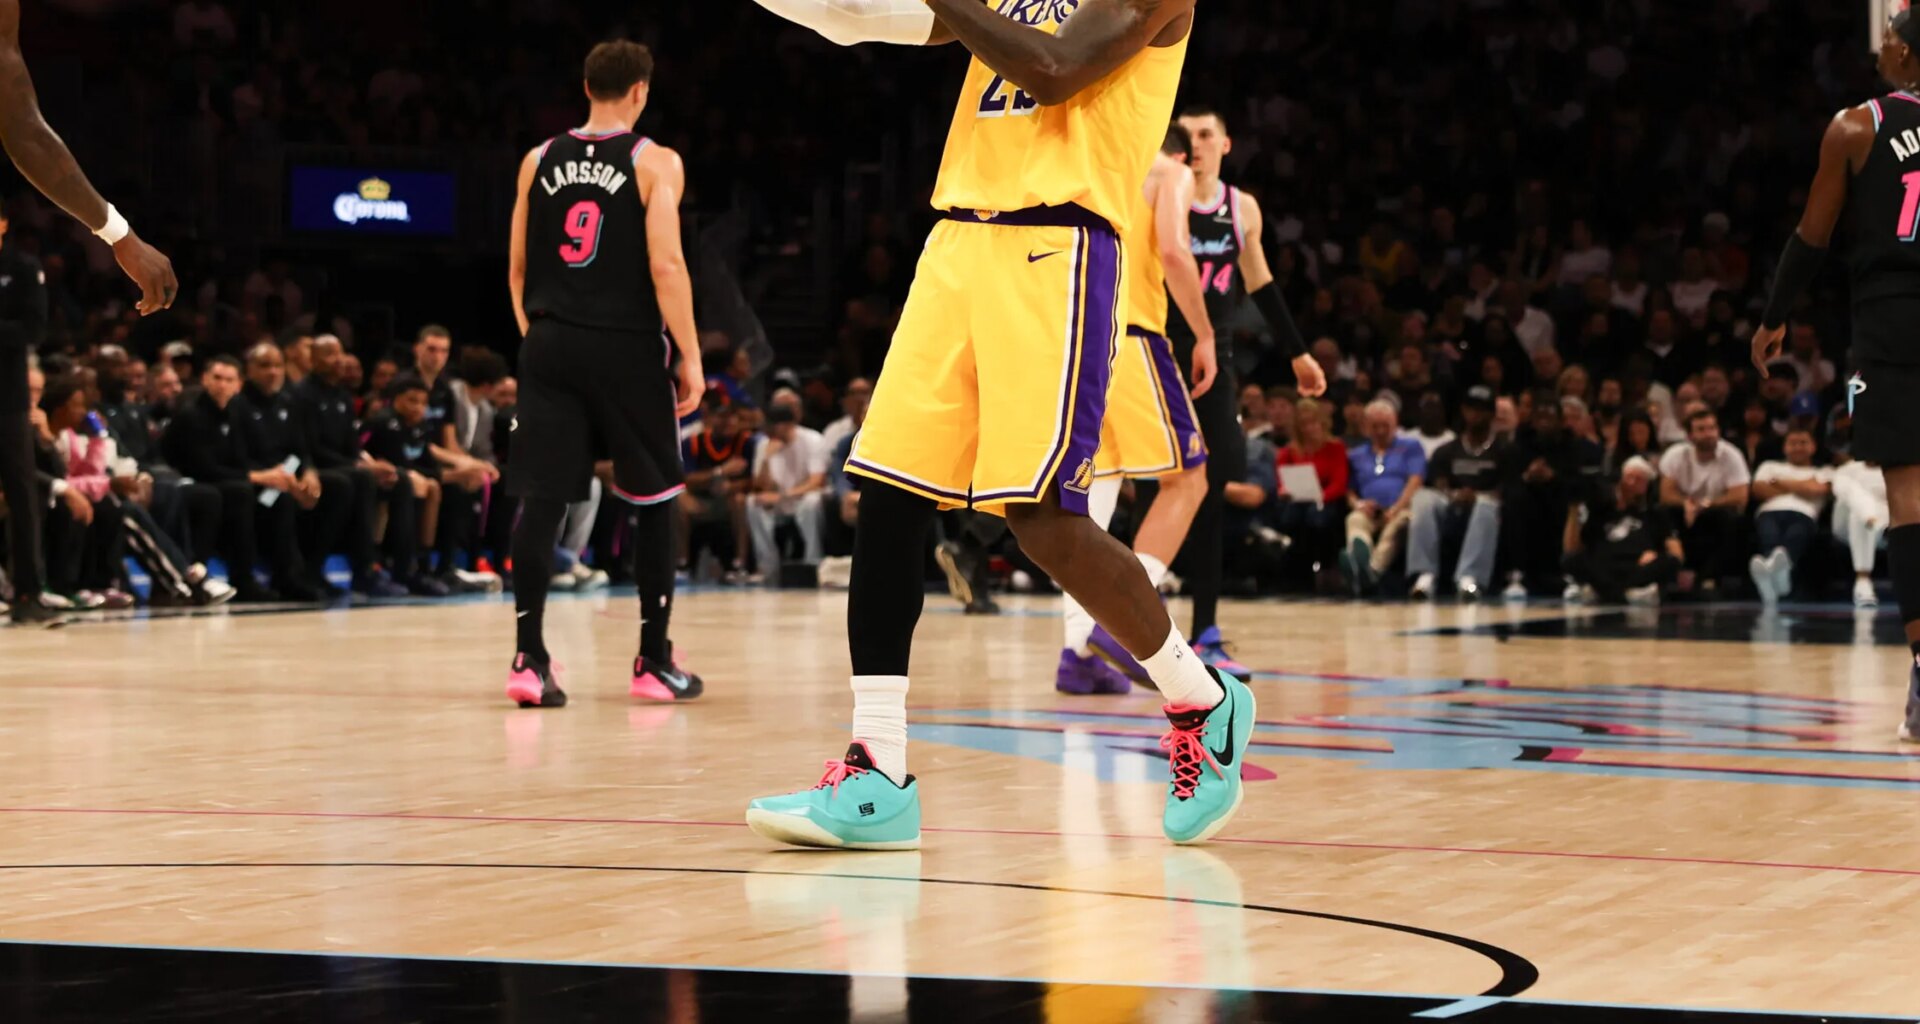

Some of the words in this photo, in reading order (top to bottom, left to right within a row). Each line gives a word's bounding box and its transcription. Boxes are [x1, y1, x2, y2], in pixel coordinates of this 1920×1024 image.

[995, 0, 1079, 25] KERS
[976, 73, 1040, 117] 2
[1889, 126, 1920, 162] AD
[540, 160, 628, 196] LARSSON
[333, 193, 409, 224] Corona
[558, 200, 604, 267] 9
[1199, 261, 1234, 295] 14
